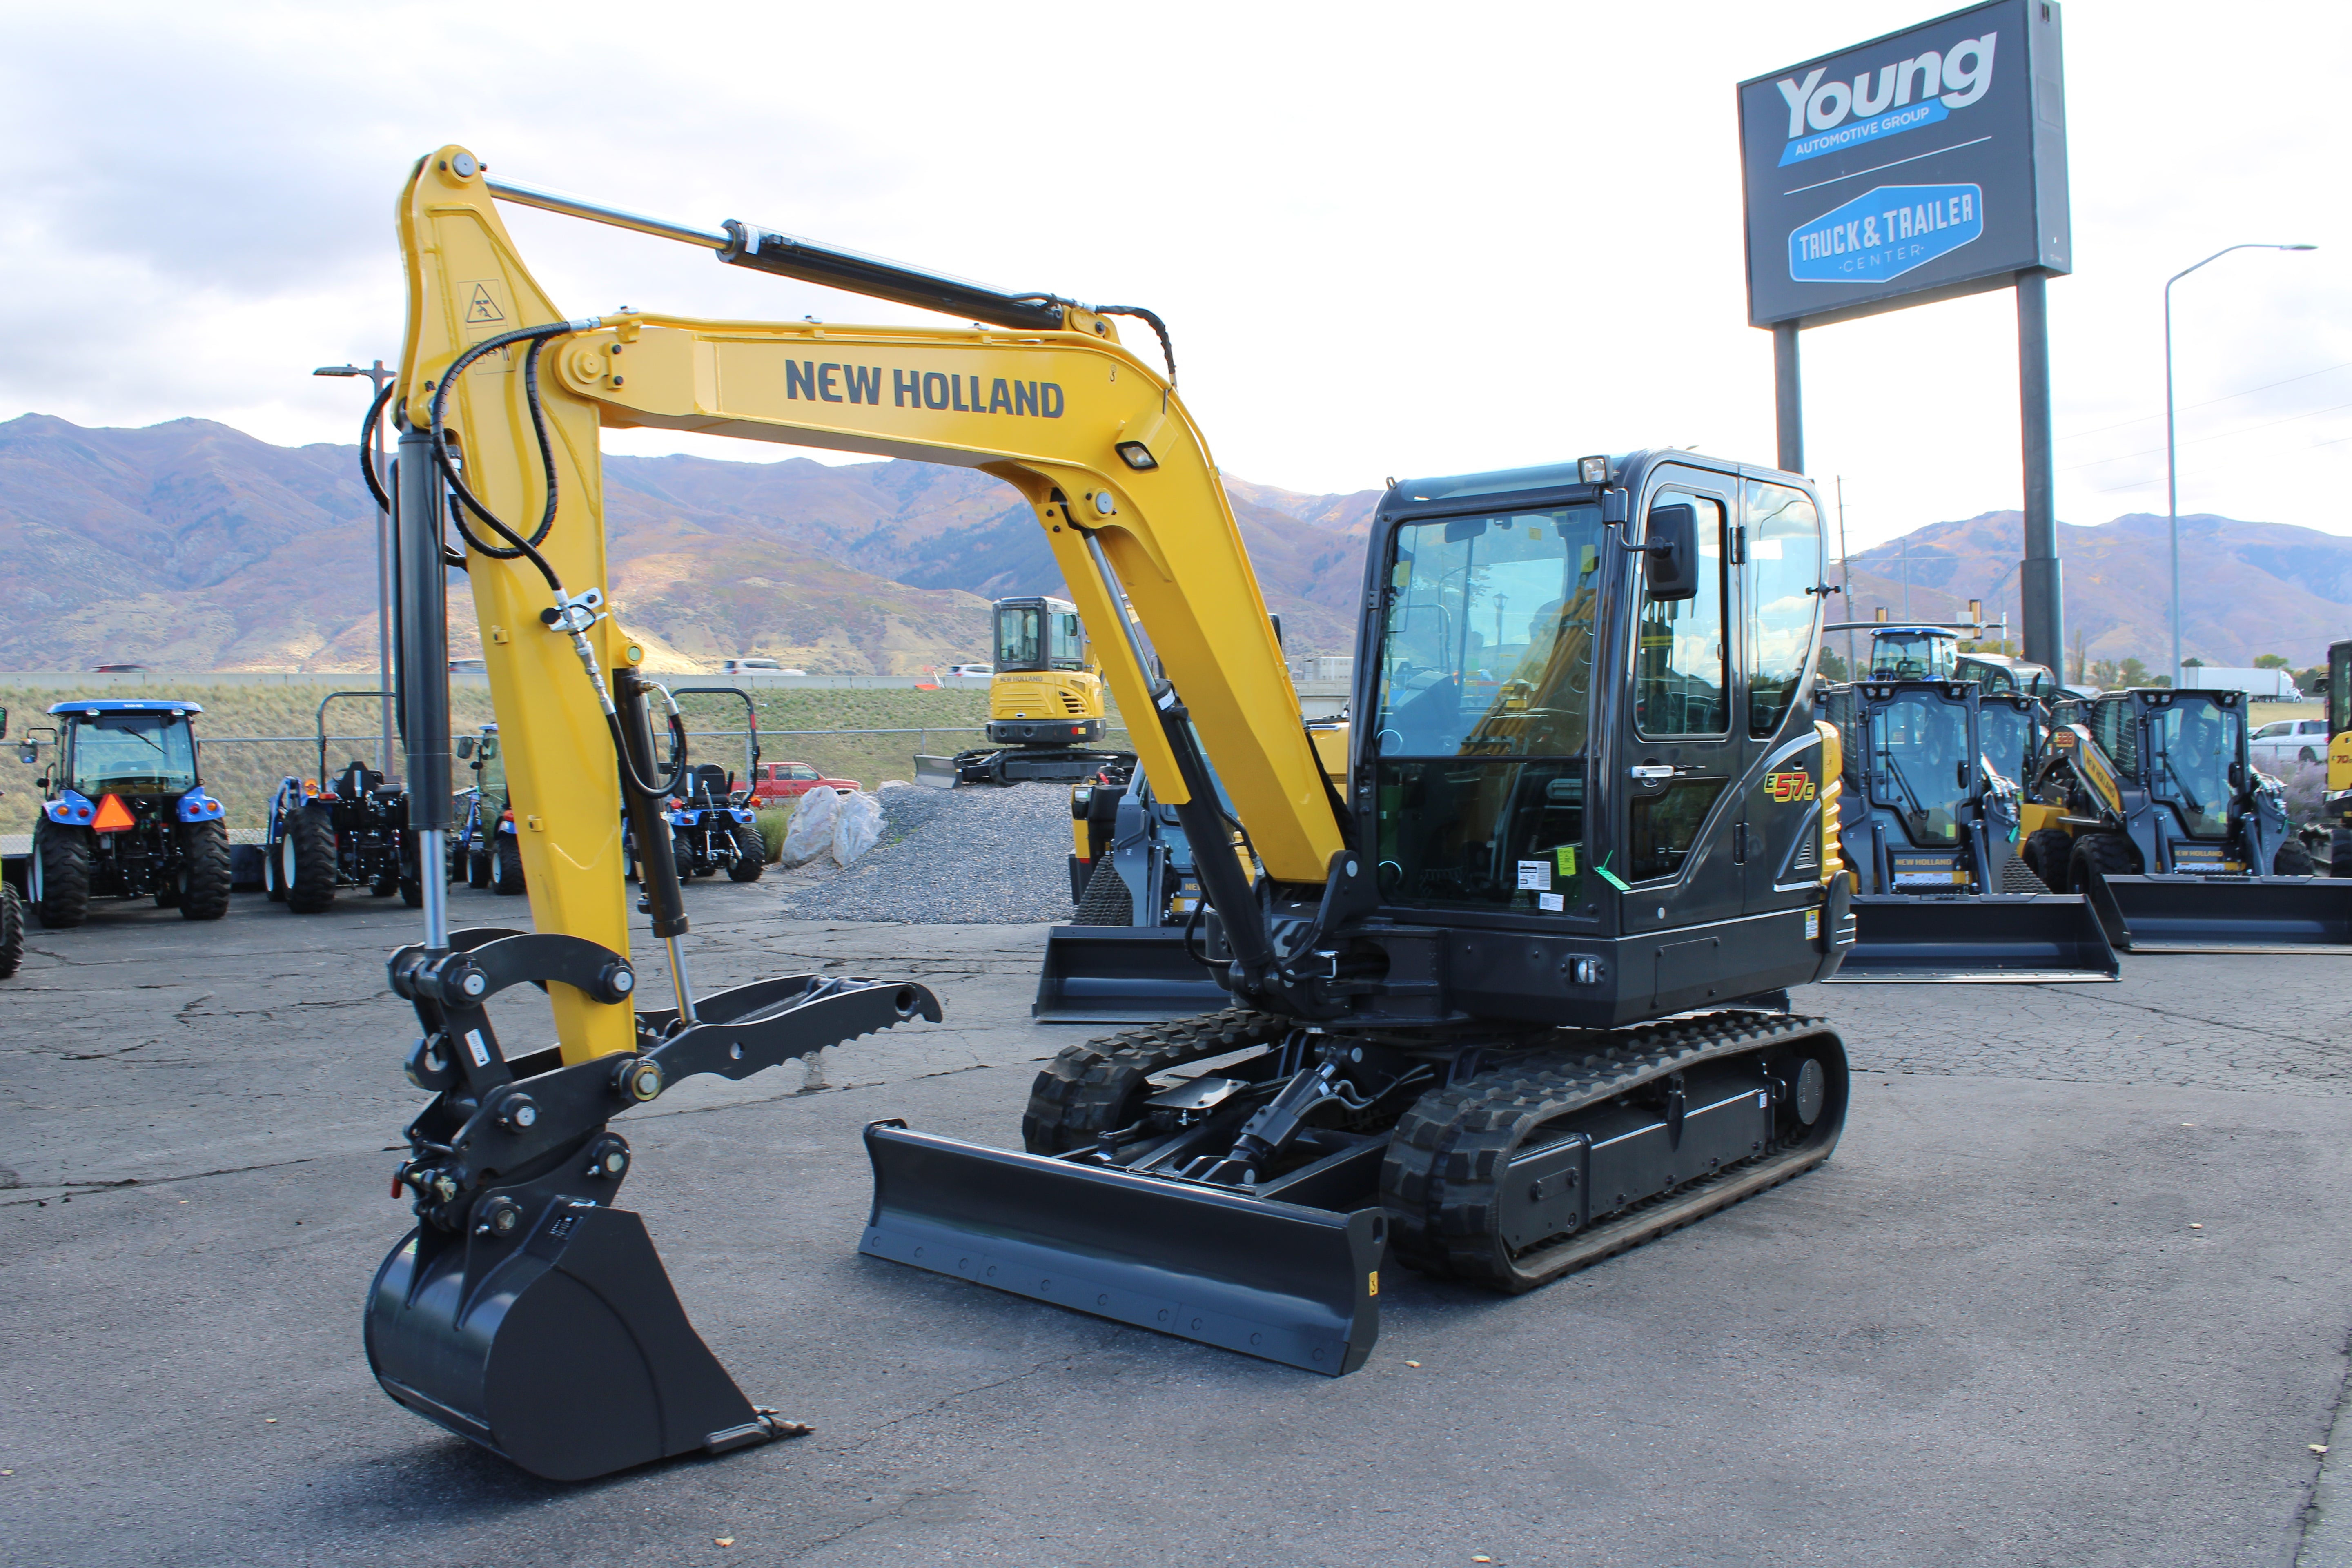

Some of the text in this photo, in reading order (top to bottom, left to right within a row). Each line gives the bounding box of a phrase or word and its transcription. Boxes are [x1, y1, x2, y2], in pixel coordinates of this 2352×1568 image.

[1776, 31, 1997, 138] Young
[1795, 107, 1929, 156] AUTOMOTIVE GROUP
[1799, 194, 1973, 261] TRUCK & TRAILER
[785, 359, 1065, 419] NEW HOLLAND
[1765, 773, 1814, 798] E57C
